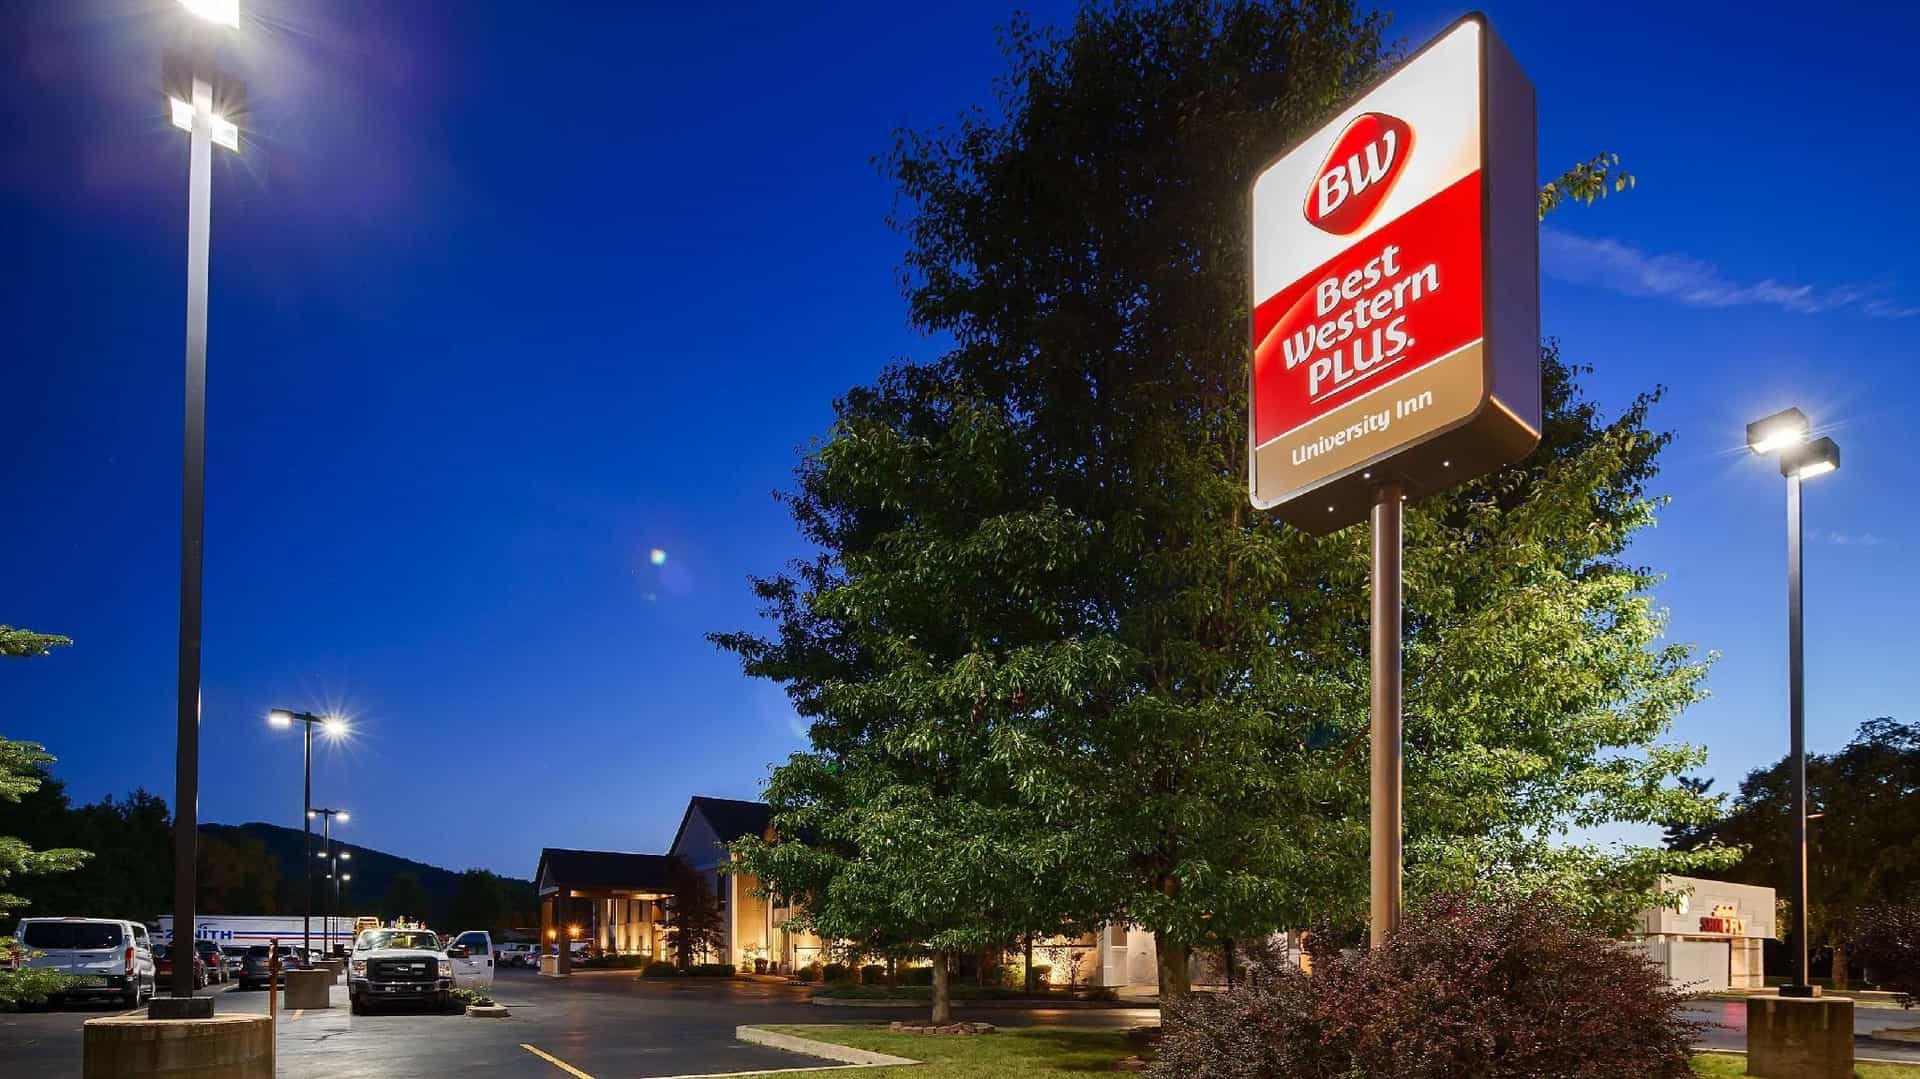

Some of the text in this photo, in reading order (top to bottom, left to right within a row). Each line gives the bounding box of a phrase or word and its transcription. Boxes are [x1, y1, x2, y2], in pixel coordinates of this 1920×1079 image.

[1318, 129, 1396, 218] BW
[1282, 263, 1440, 369] Western
[1316, 244, 1399, 317] Best
[1292, 390, 1433, 466] University Inn
